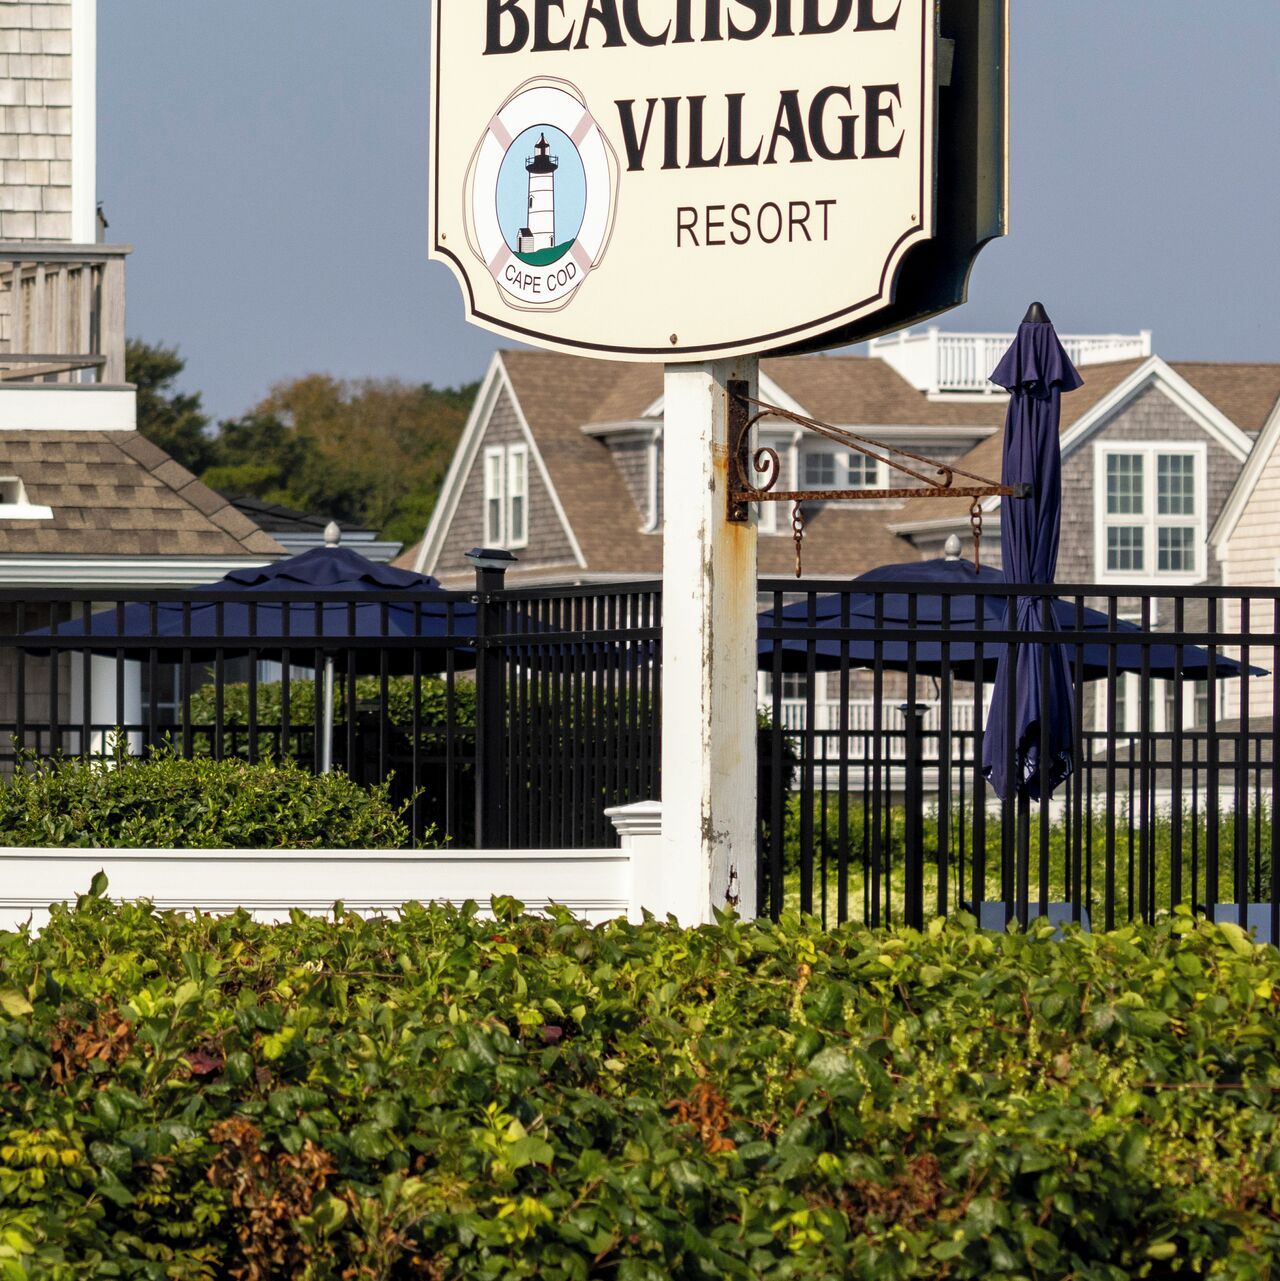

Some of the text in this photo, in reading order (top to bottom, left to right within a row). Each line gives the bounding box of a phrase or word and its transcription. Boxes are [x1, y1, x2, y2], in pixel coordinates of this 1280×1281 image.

[613, 82, 906, 172] VILLAGE
[676, 199, 837, 248] RESORT
[505, 261, 577, 294] CAPE COD
